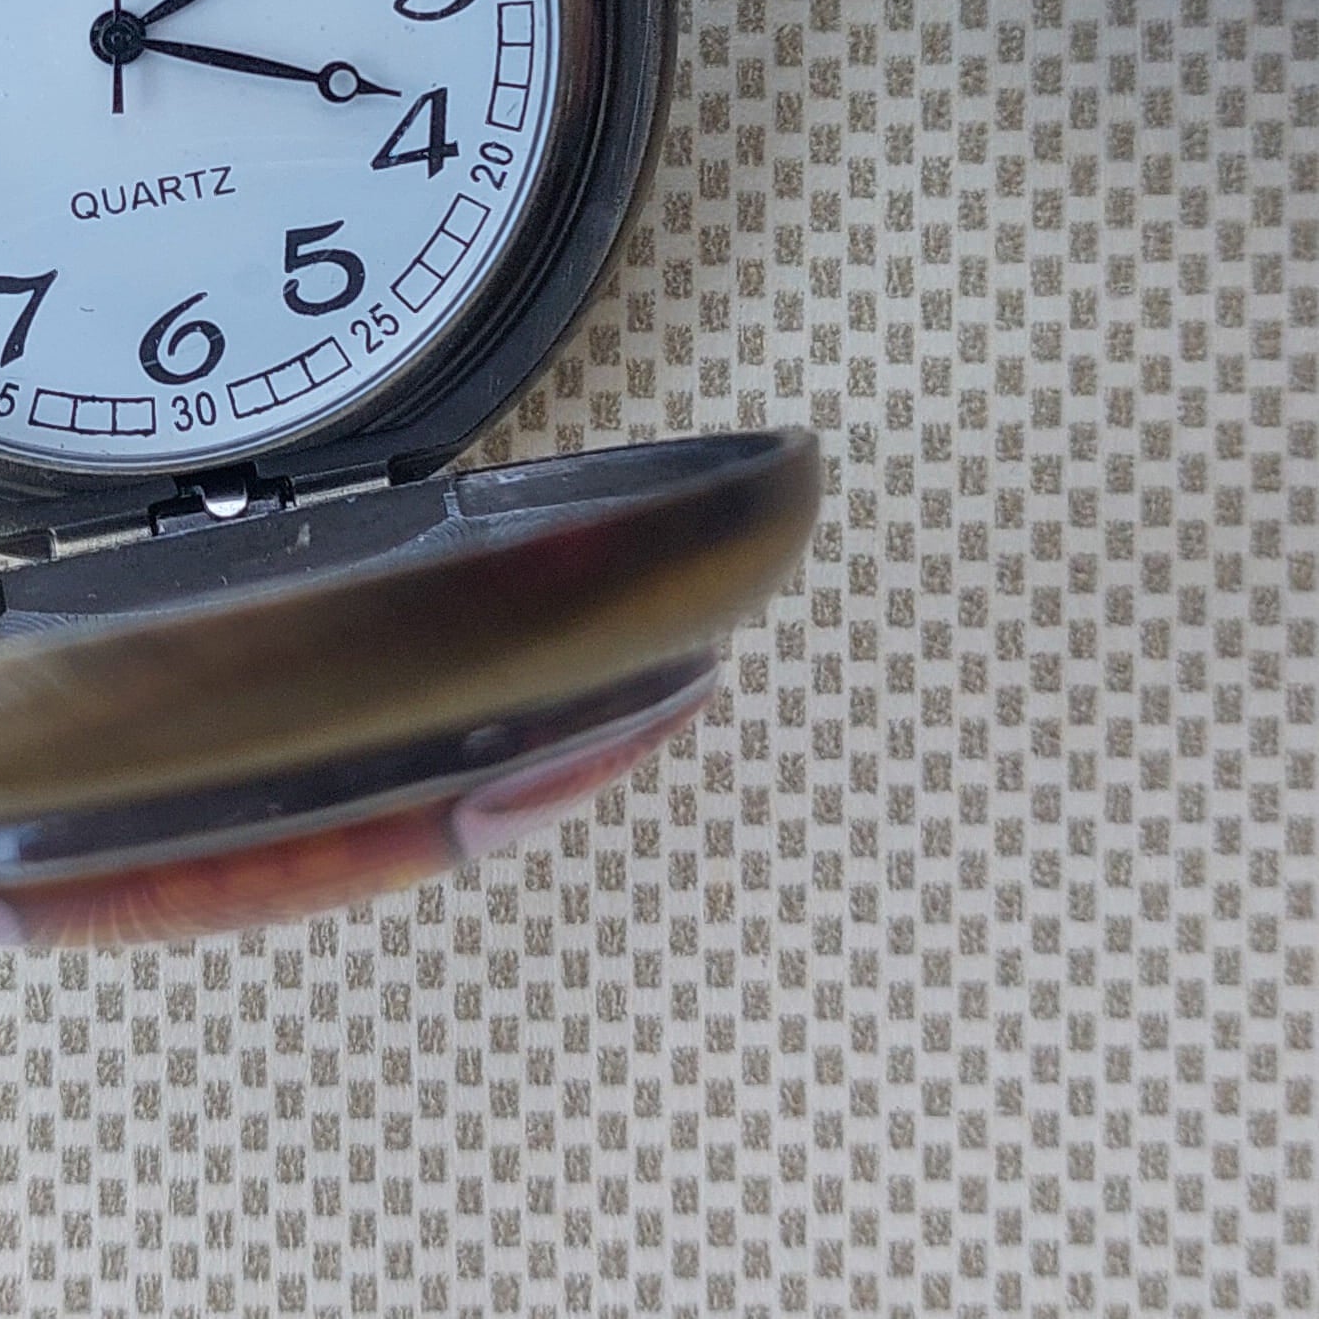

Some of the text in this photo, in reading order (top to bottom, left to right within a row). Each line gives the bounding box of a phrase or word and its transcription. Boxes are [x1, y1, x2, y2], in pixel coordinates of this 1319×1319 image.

[370, 87, 460, 179] 4
[470, 141, 513, 190] 20
[70, 166, 236, 220] QUARTZ
[283, 220, 366, 316] 5
[138, 291, 226, 385] 6
[350, 303, 400, 354] 25
[171, 391, 216, 431] 30
